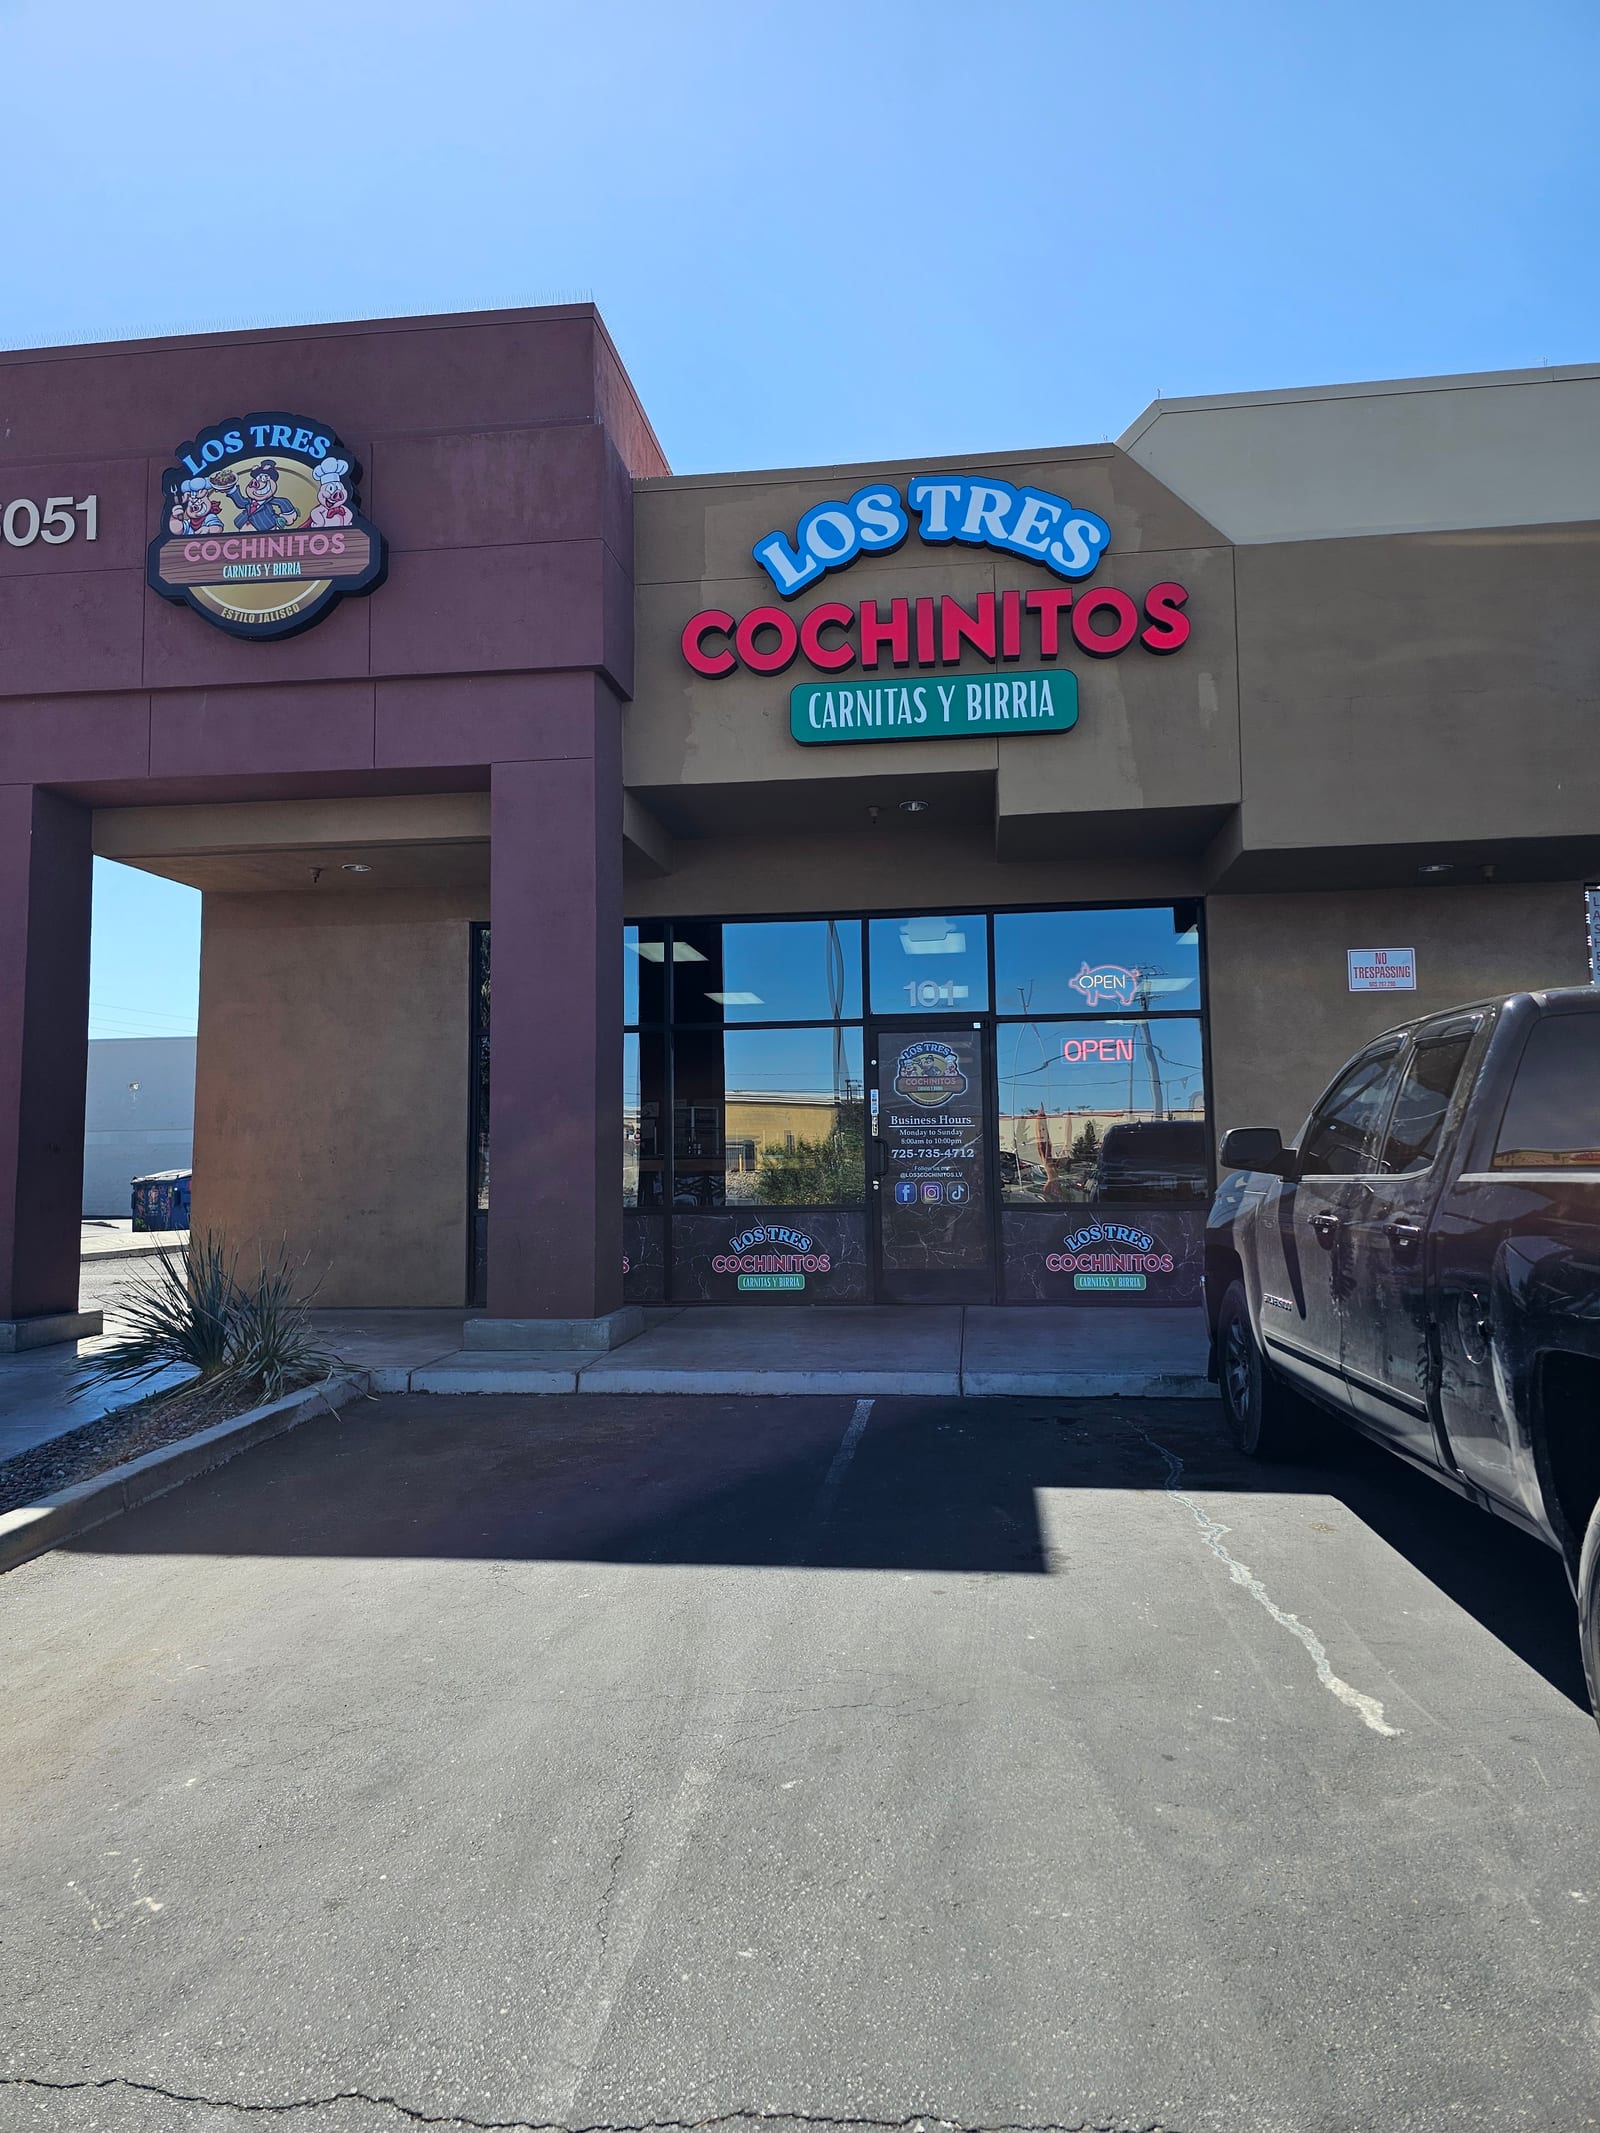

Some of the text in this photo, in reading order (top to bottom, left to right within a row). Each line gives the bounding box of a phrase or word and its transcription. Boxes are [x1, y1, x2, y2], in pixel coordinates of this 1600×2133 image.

[182, 424, 331, 476] LOS TRES
[0, 495, 97, 547] 051
[762, 484, 1101, 589] LOS TRES
[184, 532, 346, 562] COCHINITOS
[222, 562, 301, 579] CARNITAS Y BIRRIA
[220, 603, 301, 624] ESTILO JALISCO
[681, 582, 1191, 679] COCHINITOS
[808, 679, 1055, 729] CARNITAS Y BIRRIA
[1375, 952, 1387, 965] NO
[1079, 974, 1126, 989] OPEN
[1353, 966, 1411, 979] TRESPASSING
[903, 980, 954, 1007] 101
[903, 1043, 950, 1059] LOS TRES
[1064, 1039, 1133, 1062] OPEN
[905, 1077, 956, 1086] COCHINITOS
[891, 1115, 972, 1125] Business Hours
[900, 1129, 927, 1137] Monday
[937, 1129, 963, 1137] Sunday
[891, 1148, 975, 1159] 725-735-4712
[731, 1226, 812, 1252] LOS TRES
[1065, 1225, 1152, 1251] LOS TRES
[712, 1254, 831, 1273] COCHINITOS
[1046, 1253, 1174, 1272] COCHINITOS
[742, 1276, 800, 1287] CARNITAS Y BIRRIA
[1079, 1276, 1141, 1288] CARNITAS Y BIRRIA
